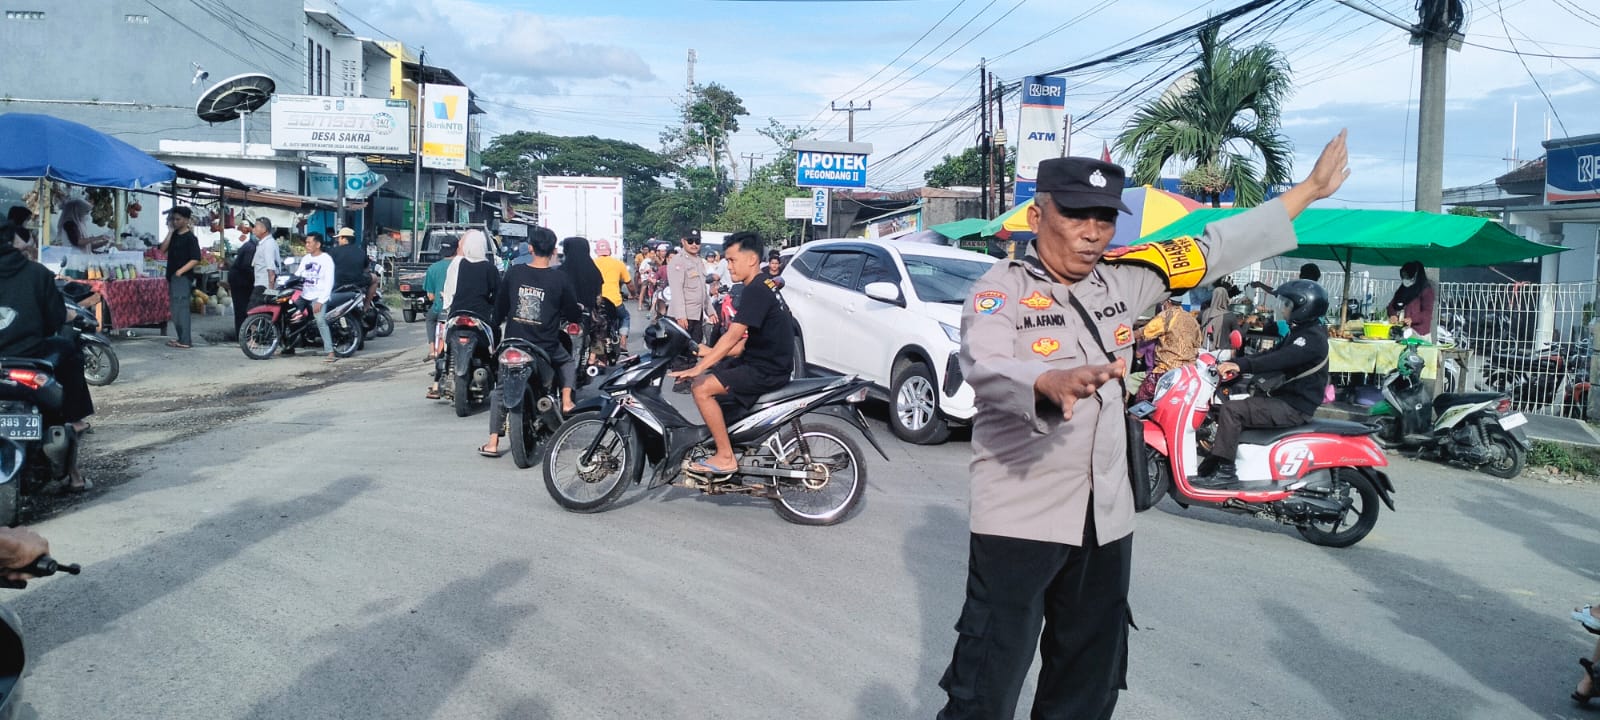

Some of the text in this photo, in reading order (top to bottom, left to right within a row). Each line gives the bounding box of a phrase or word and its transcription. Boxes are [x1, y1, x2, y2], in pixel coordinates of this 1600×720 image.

[1041, 85, 1061, 97] BRI
[311, 132, 371, 143] DESA SAKRA
[1028, 131, 1056, 141] ATM
[799, 152, 865, 171] APOTEK
[804, 170, 859, 181] PEGONDANG II
[815, 190, 825, 224] APOTEK
